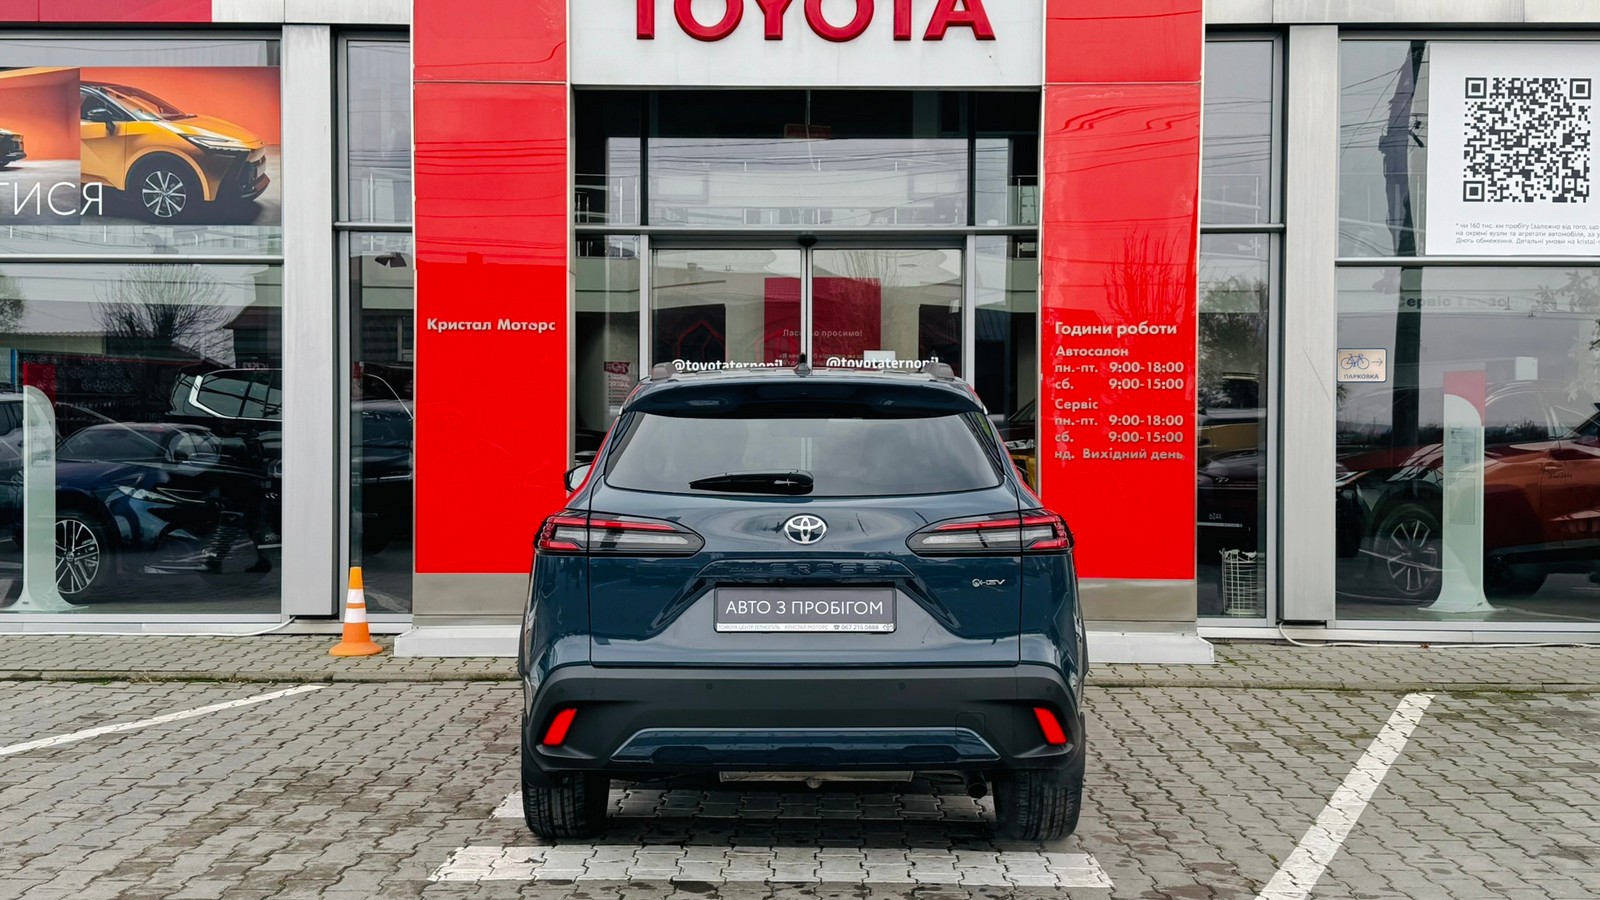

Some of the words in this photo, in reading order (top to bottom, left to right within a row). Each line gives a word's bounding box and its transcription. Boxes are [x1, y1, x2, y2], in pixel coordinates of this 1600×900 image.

[636, 0, 996, 42] TOYOTA
[1505, 222, 1530, 230] пробігу
[1465, 230, 1488, 238] окремі
[426, 318, 492, 333] Кристал
[497, 318, 556, 333] Моторс
[1055, 321, 1113, 336] Години
[1117, 320, 1177, 338] роботи
[821, 329, 863, 338] просимо!
[1055, 345, 1129, 357] Автосалон
[1055, 364, 1099, 373] пн.-пт.
[1109, 361, 1185, 373] 9:00-18:00
[1055, 377, 1074, 390] сб.
[1108, 378, 1184, 390] 9:00-15:00
[1055, 397, 1099, 412] Сервіс
[1055, 417, 1099, 426] пн.-пт.
[1108, 414, 1184, 426] 9:00-18:00
[1055, 430, 1074, 443] сб.
[1108, 431, 1184, 443] 9:00-15:00
[1055, 450, 1075, 460] нд.
[1082, 447, 1147, 460] Вихідний
[1150, 450, 1184, 460] день
[725, 600, 771, 615] АВТО
[791, 600, 884, 615] ПРОБІГОМ
